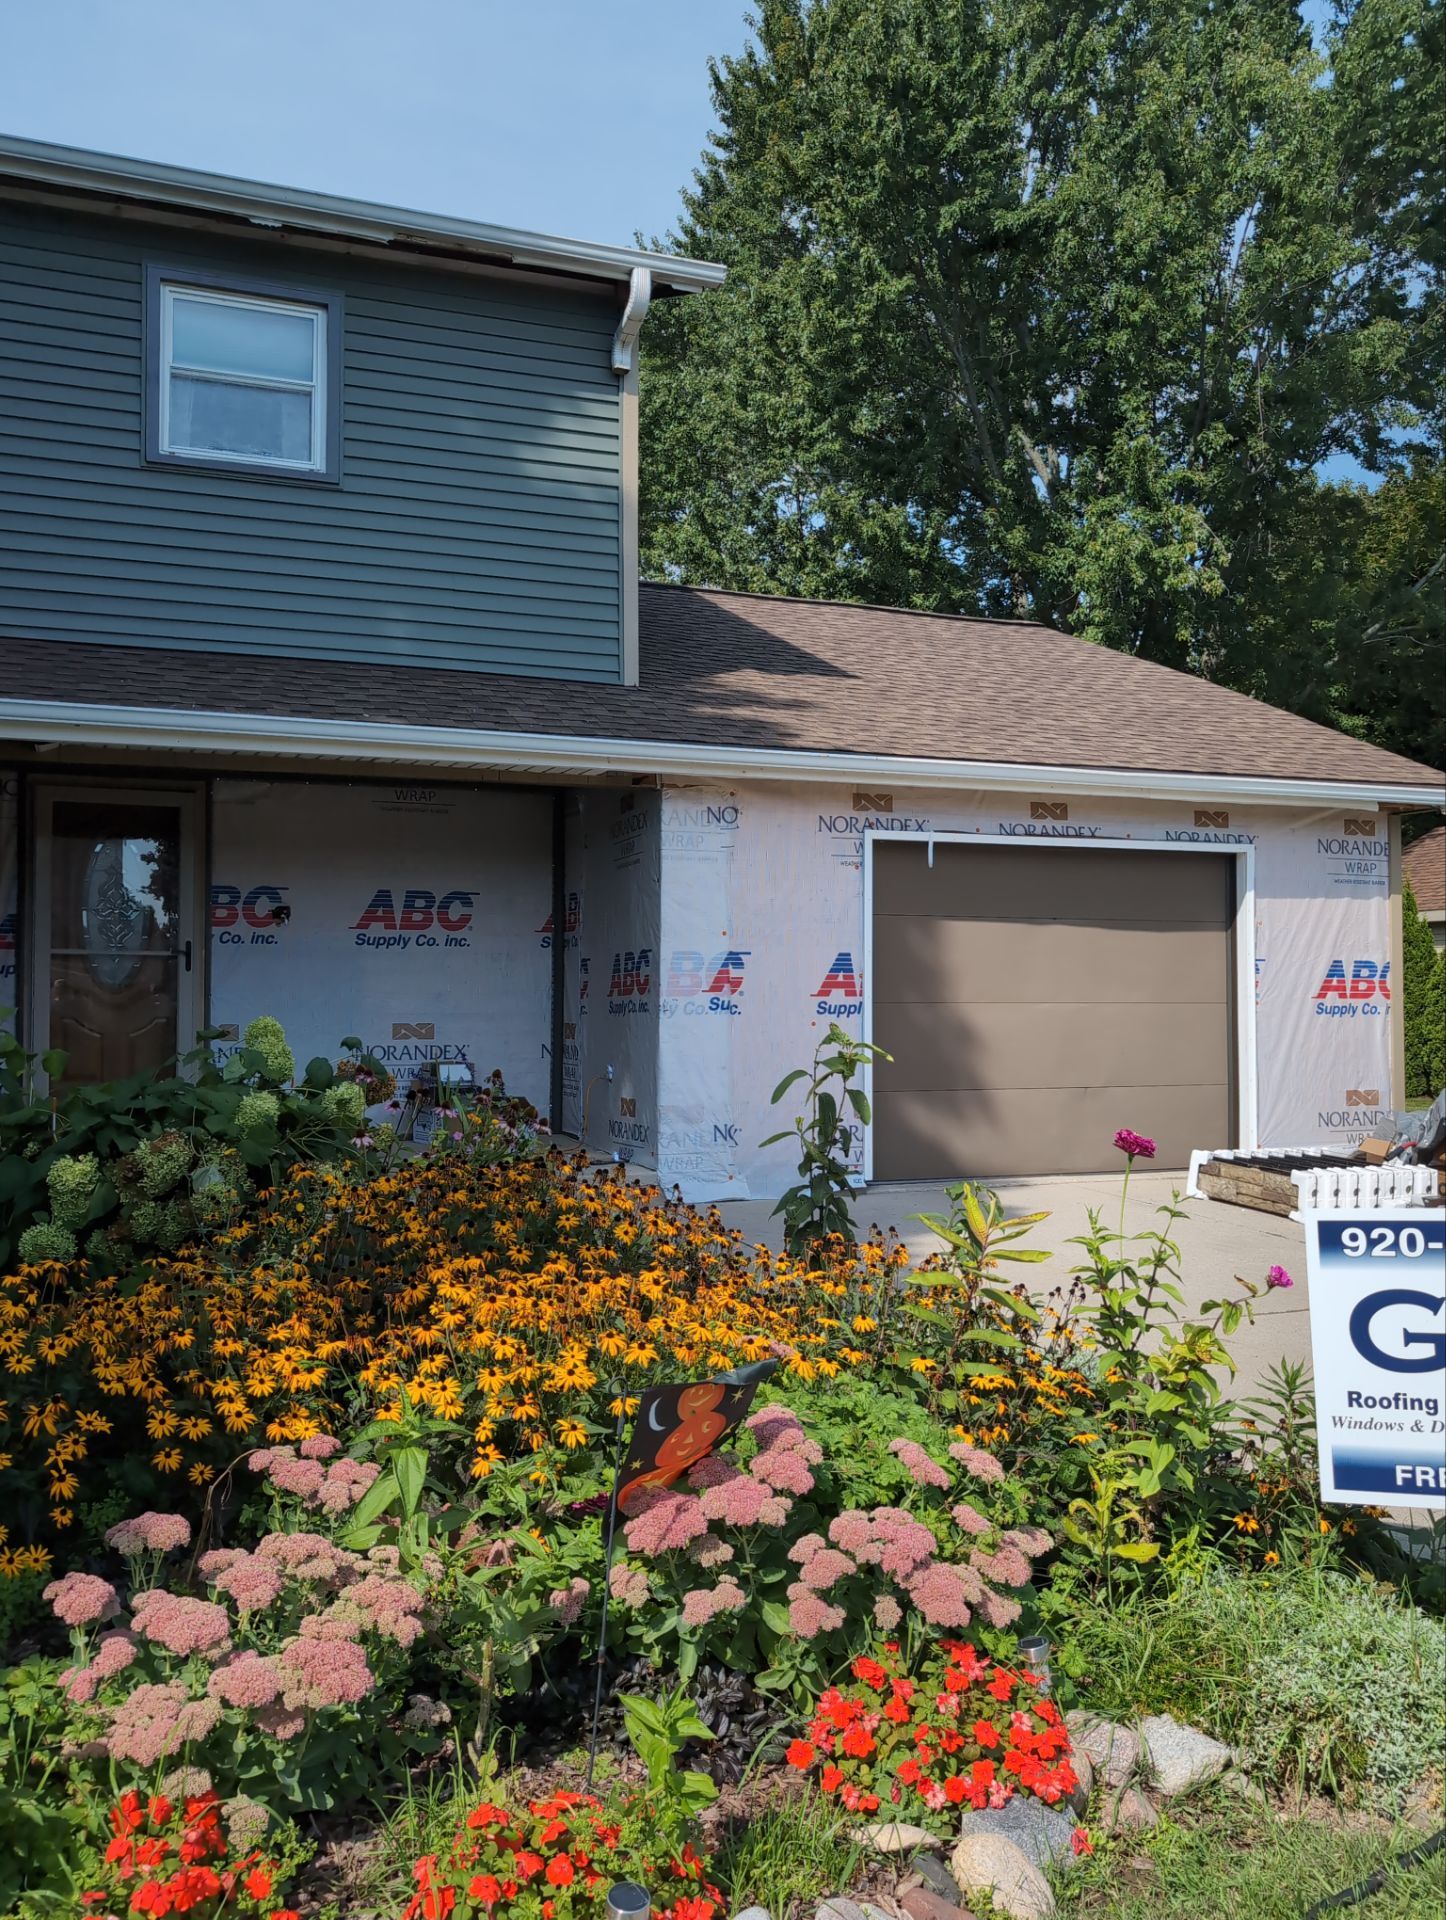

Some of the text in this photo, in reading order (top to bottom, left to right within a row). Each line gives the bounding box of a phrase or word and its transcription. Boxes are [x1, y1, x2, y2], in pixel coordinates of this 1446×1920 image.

[395, 789, 436, 802] WRAP
[1344, 861, 1377, 874] WRAP
[348, 889, 480, 932] ABC
[219, 931, 279, 945] Co. inc.
[354, 933, 471, 950] Supply Co. inc.
[607, 948, 653, 998] ABC
[816, 1001, 864, 1018] Suppl
[1315, 1002, 1358, 1018] Supply
[1361, 1003, 1380, 1016] Co.
[608, 1119, 649, 1145] NORANDEX
[1341, 1226, 1443, 1258] 920-
[1347, 1390, 1439, 1416] Roofing
[1331, 1415, 1404, 1432] Windows
[1410, 1419, 1424, 1433] &
